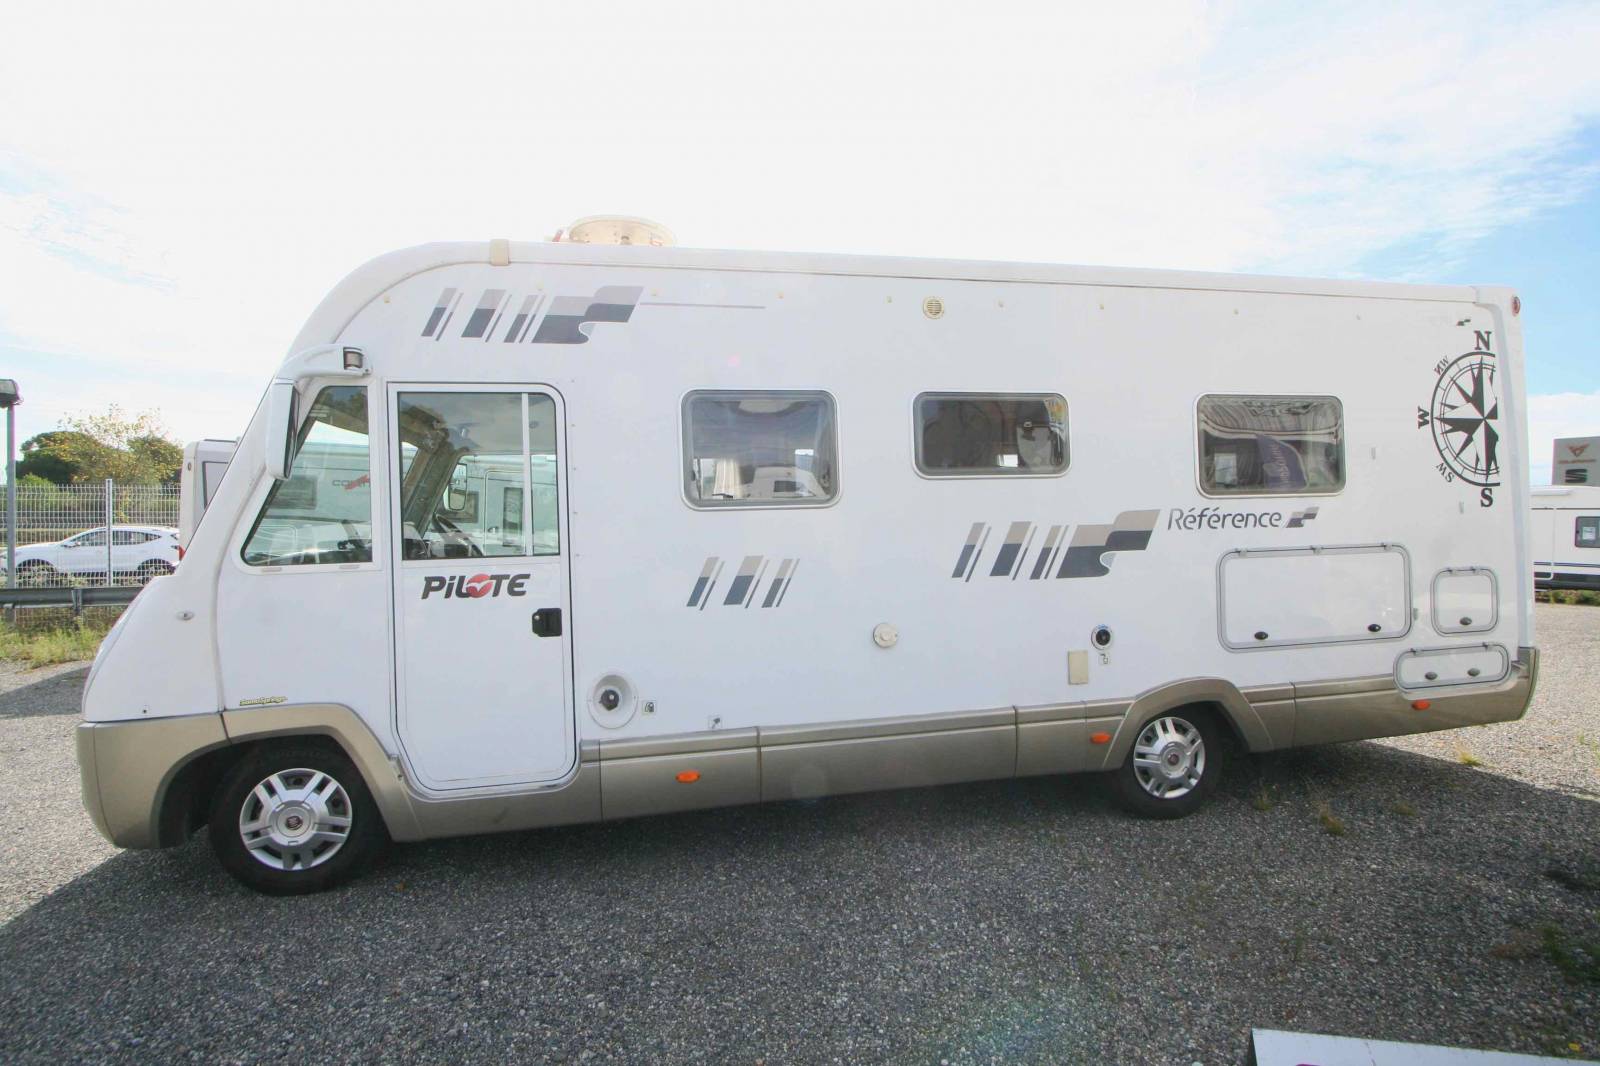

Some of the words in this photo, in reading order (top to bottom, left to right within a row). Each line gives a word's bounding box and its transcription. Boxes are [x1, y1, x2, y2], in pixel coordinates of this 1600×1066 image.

[1473, 330, 1492, 351] N
[1417, 405, 1430, 430] W
[1480, 487, 1494, 508] S
[1167, 506, 1282, 530] Référence
